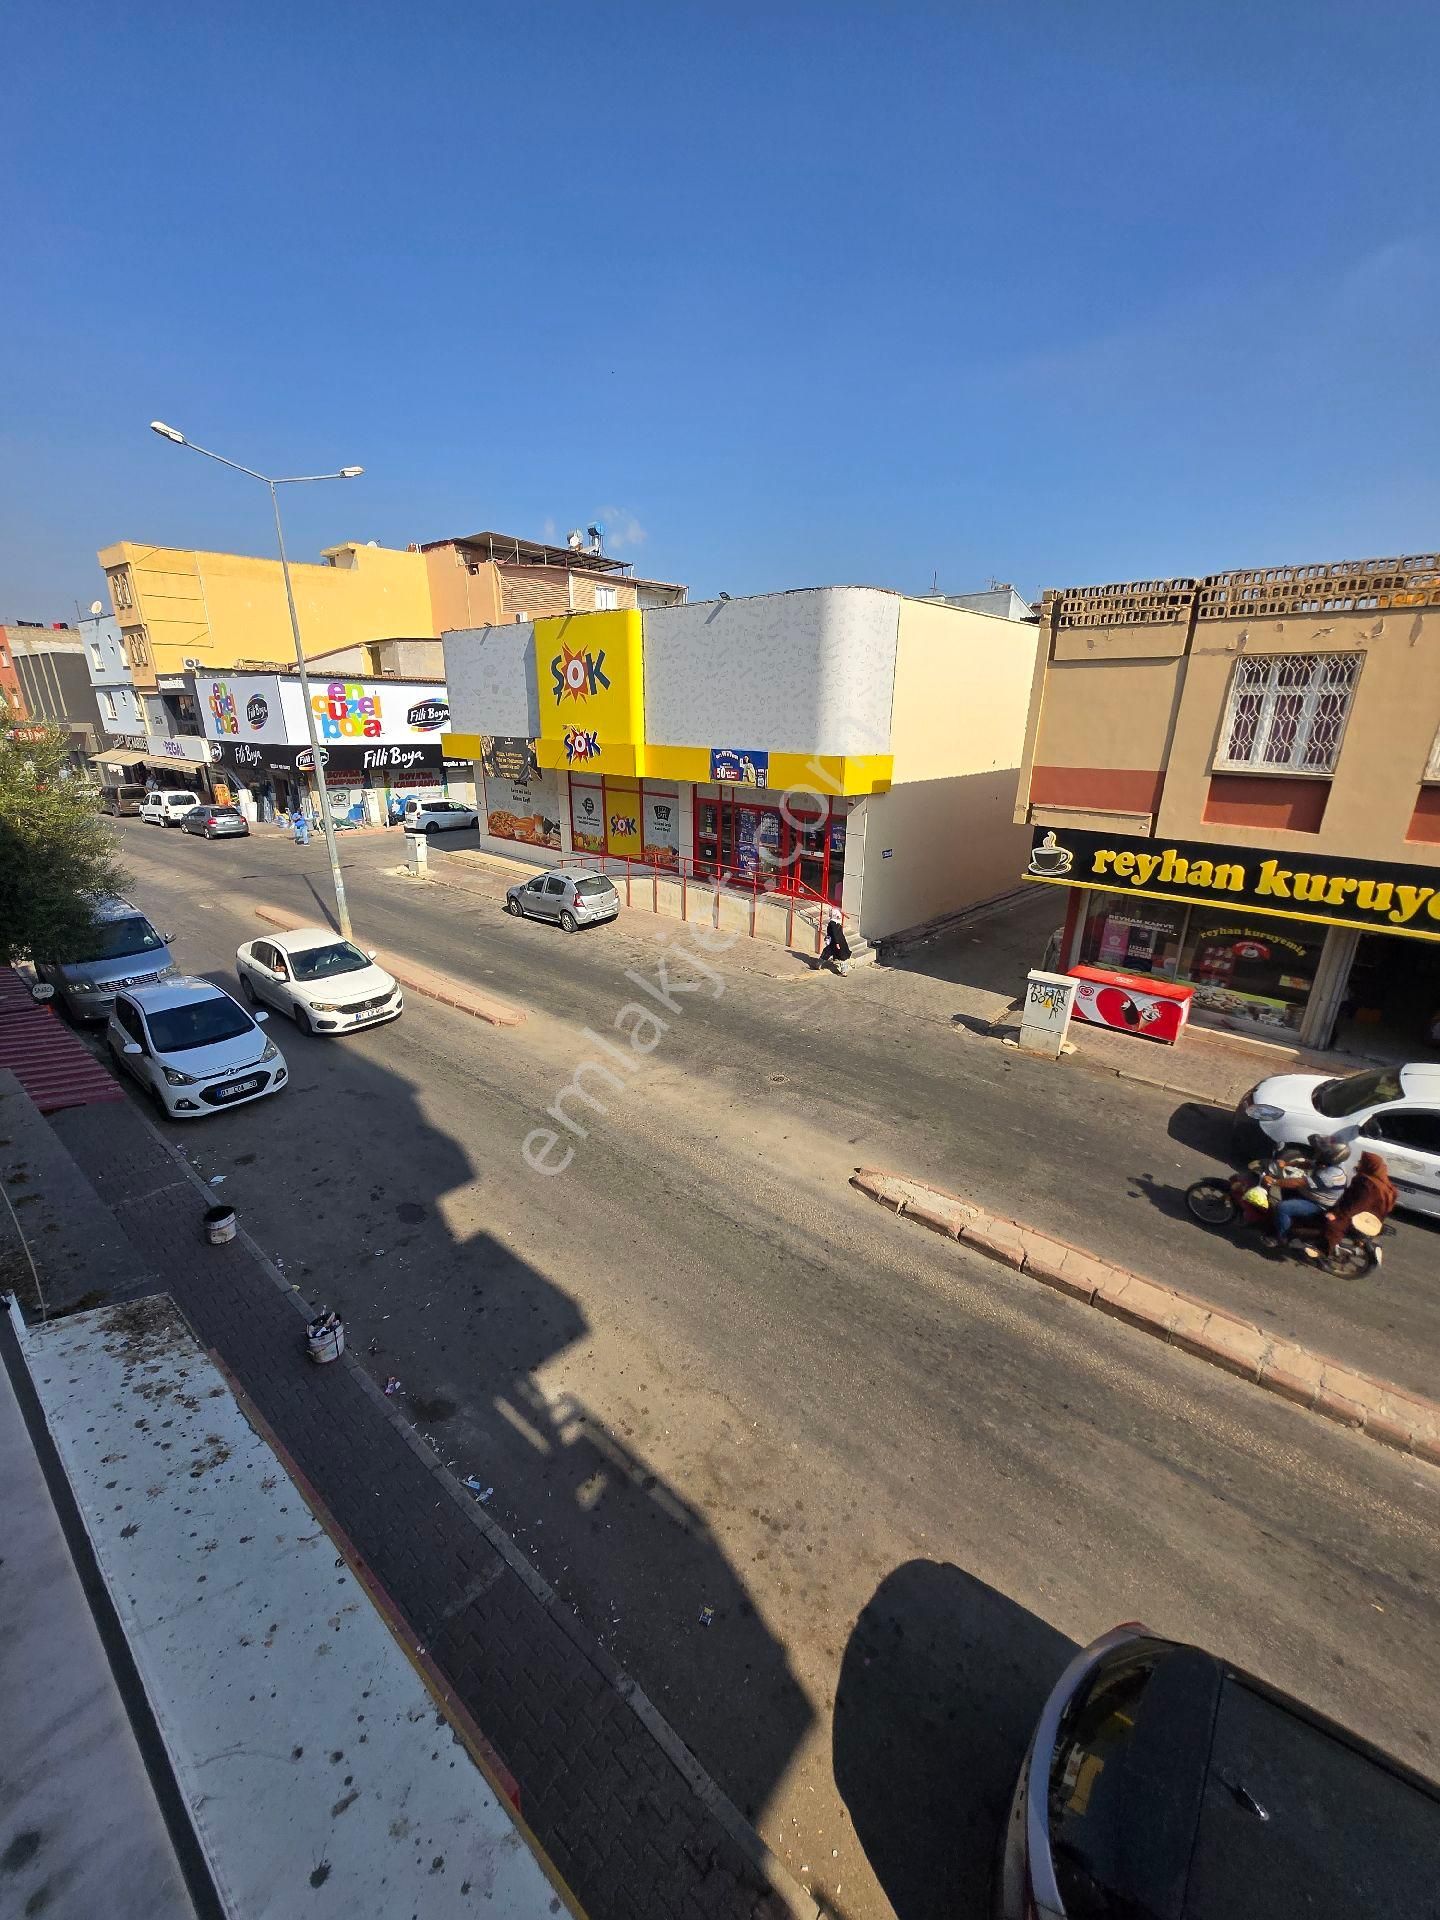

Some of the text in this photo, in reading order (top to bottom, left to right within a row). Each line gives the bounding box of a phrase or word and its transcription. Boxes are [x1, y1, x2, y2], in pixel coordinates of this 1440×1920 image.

[551, 649, 611, 706] ŞOK
[327, 682, 365, 702] en
[322, 713, 381, 738] boya
[409, 706, 450, 722] Filli Boya
[245, 744, 262, 767] Boya
[364, 746, 388, 769] Filli
[389, 747, 425, 768] Boya
[564, 731, 601, 766] ŞOK
[1092, 849, 1244, 892] reyhan
[1200, 928, 1241, 938] reyhan
